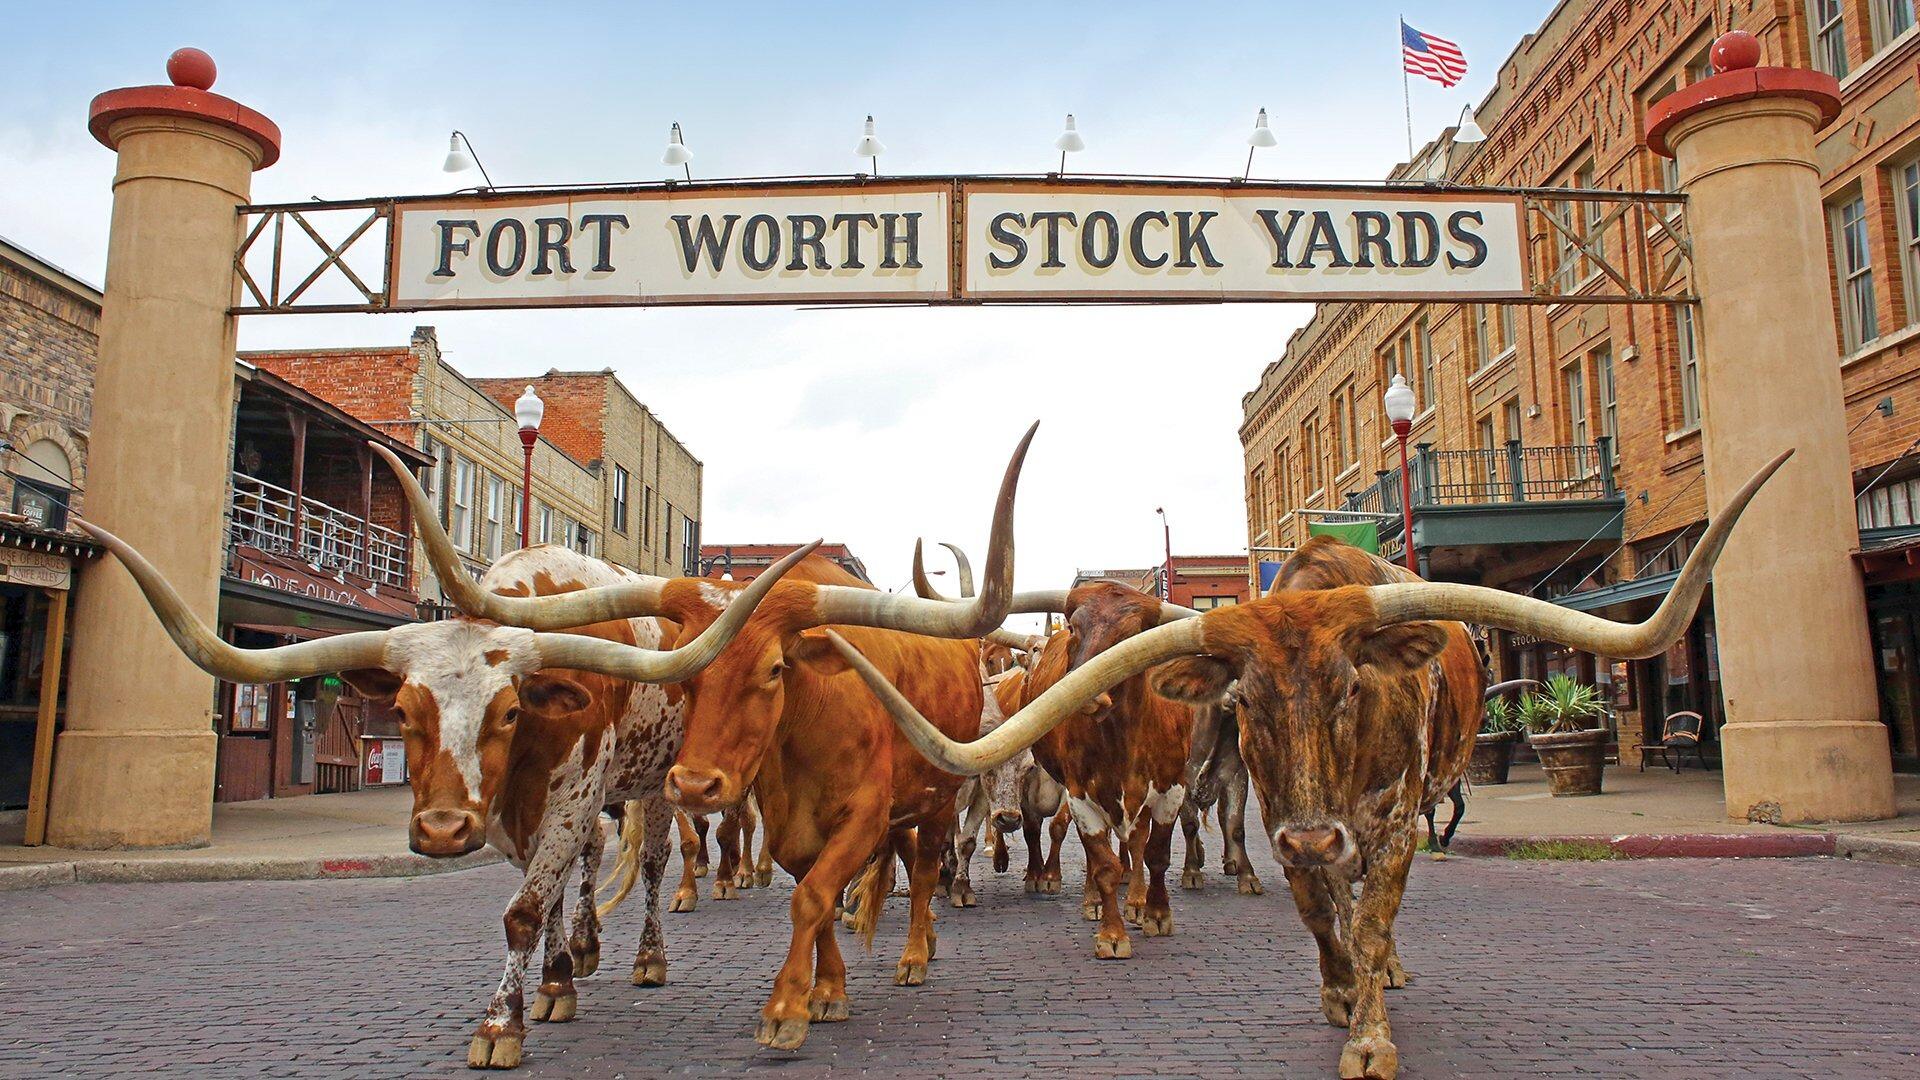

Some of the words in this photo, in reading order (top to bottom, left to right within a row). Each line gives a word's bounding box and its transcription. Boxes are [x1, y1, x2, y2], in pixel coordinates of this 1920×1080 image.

[433, 214, 629, 277] FORT
[671, 212, 923, 274] WORTH
[988, 210, 1224, 270] STOCK
[1256, 210, 1489, 270] YARDS
[1379, 538, 1402, 558] OTEL
[20, 553, 32, 565] OF
[34, 554, 66, 570] BLADES
[14, 567, 34, 579] KNIFE
[37, 569, 58, 582] ALLEY
